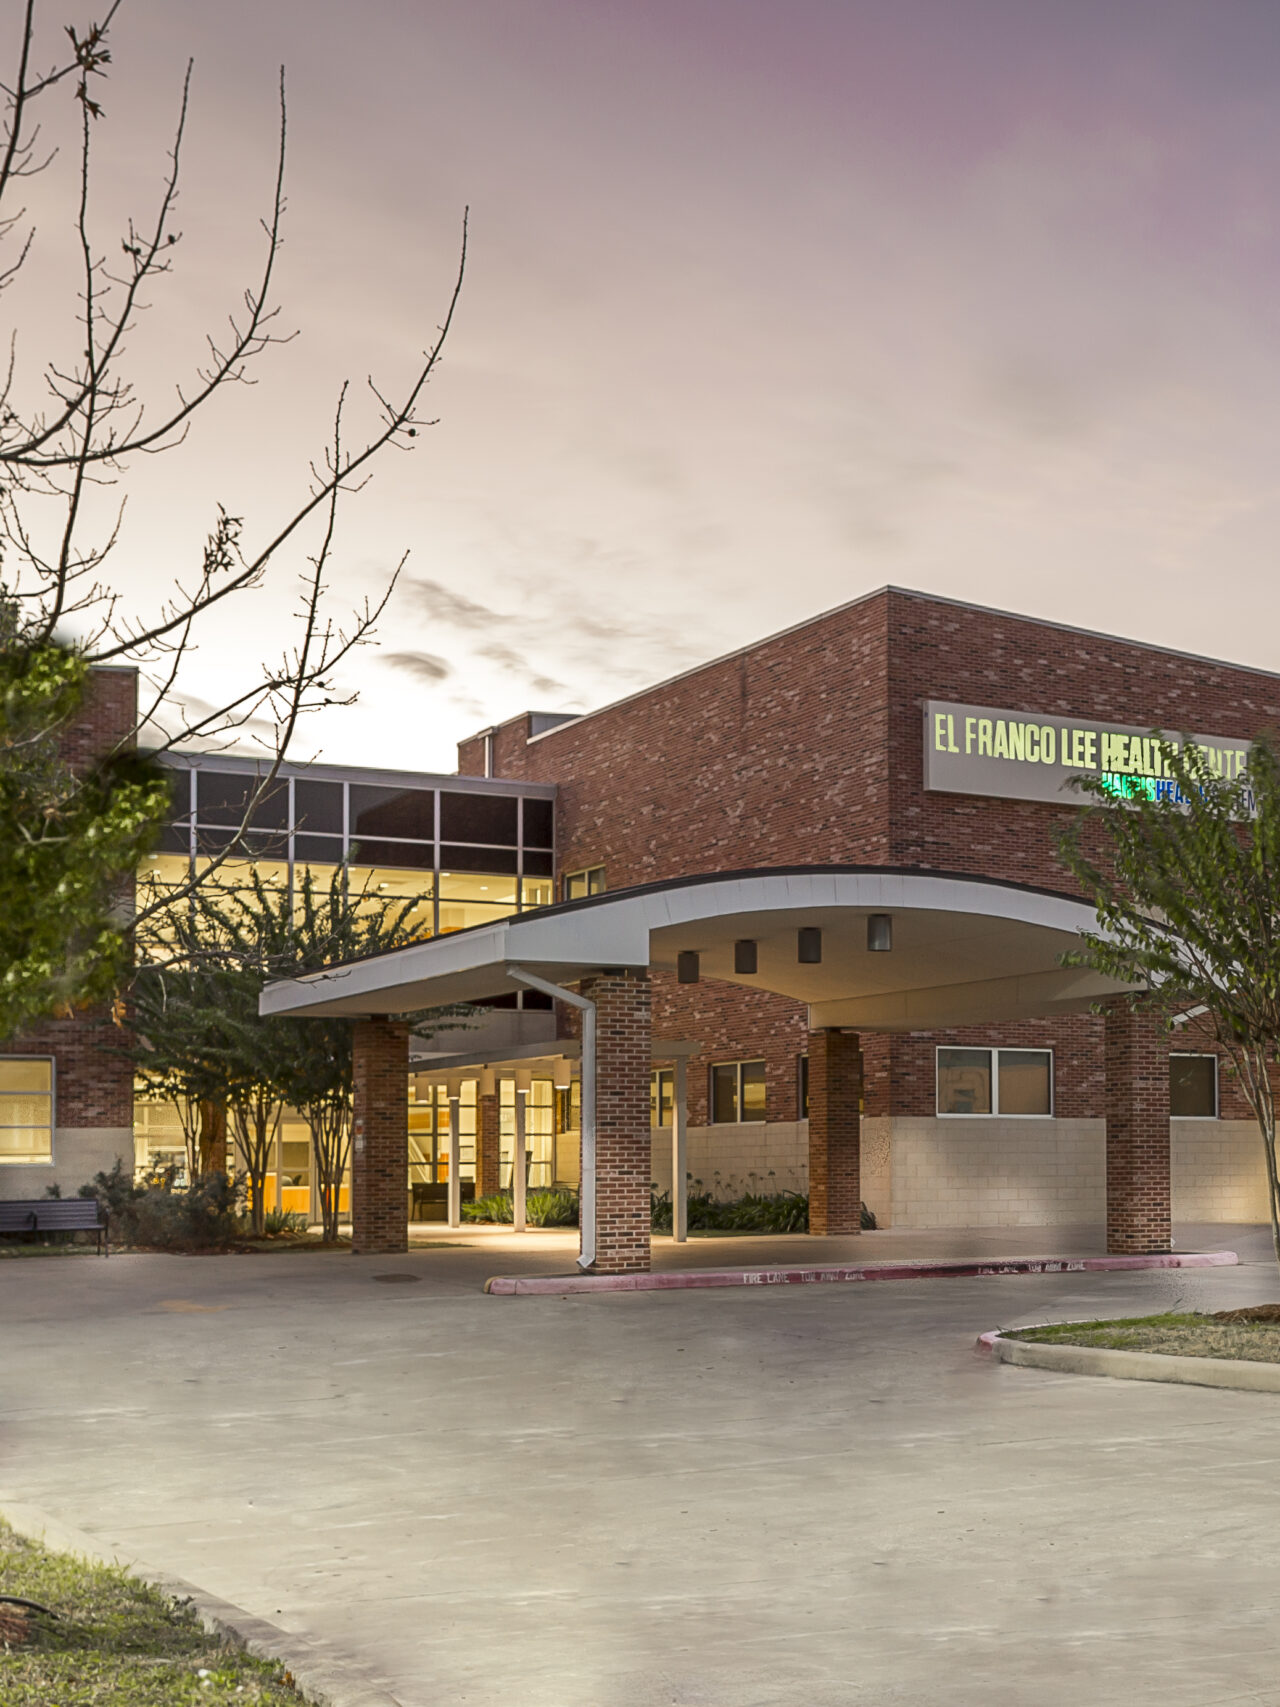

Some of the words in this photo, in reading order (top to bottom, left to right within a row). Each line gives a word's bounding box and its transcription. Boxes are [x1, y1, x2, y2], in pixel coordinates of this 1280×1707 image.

[935, 713, 960, 754] EL
[965, 716, 1056, 765] FRANCO
[1061, 728, 1097, 770] LEE
[1101, 732, 1179, 778] HEALTH
[1183, 743, 1246, 781] CENTE
[743, 1273, 763, 1284] FIRE
[767, 1272, 790, 1283] LANE
